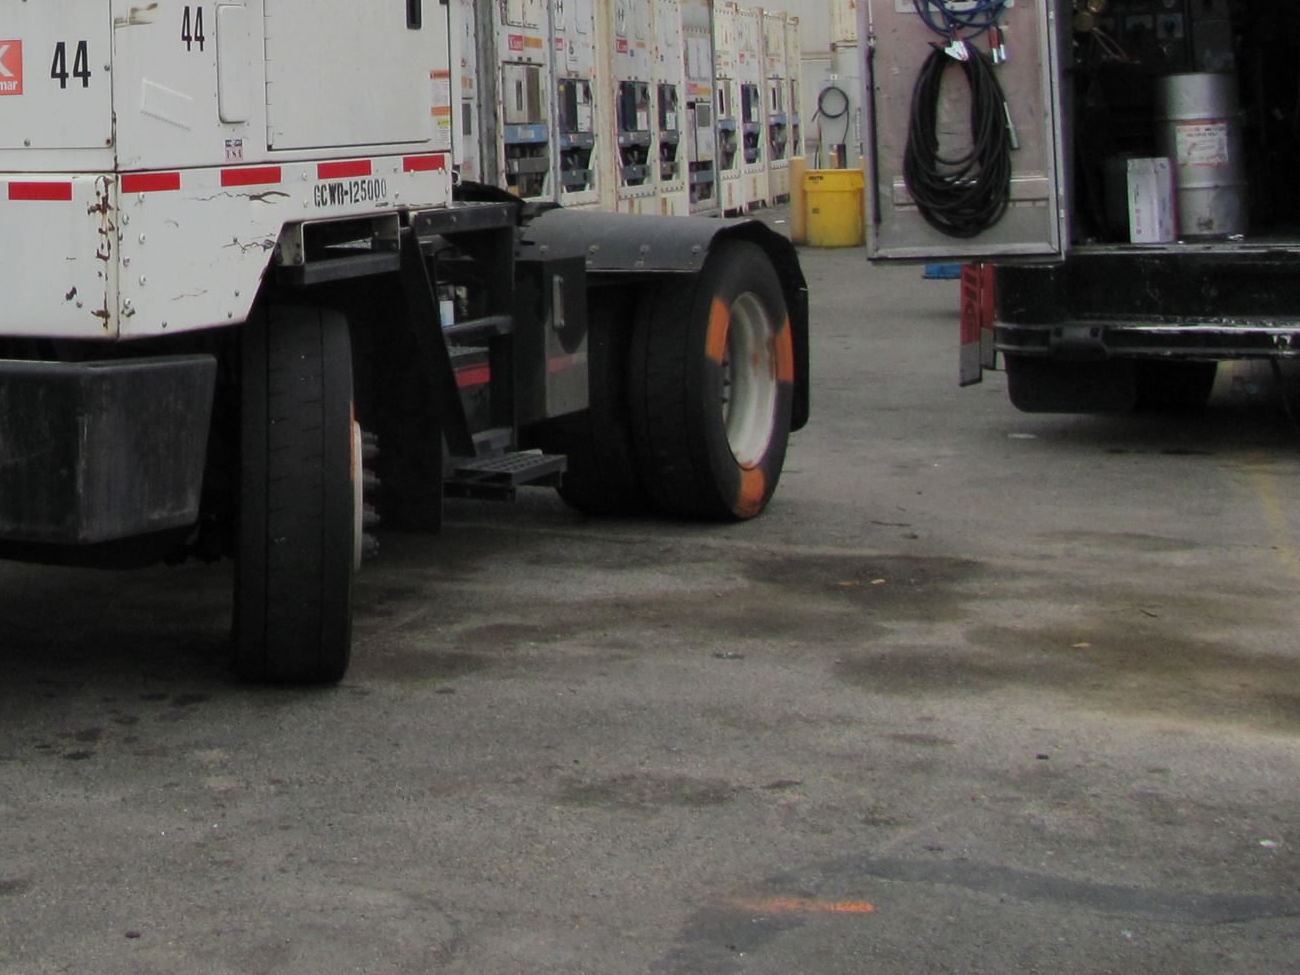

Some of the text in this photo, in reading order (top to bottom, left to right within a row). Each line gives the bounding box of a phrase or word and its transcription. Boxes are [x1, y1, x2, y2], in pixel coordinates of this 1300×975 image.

[181, 5, 205, 52] 44
[50, 40, 92, 89] 44
[313, 178, 387, 207] GCWR-125000
